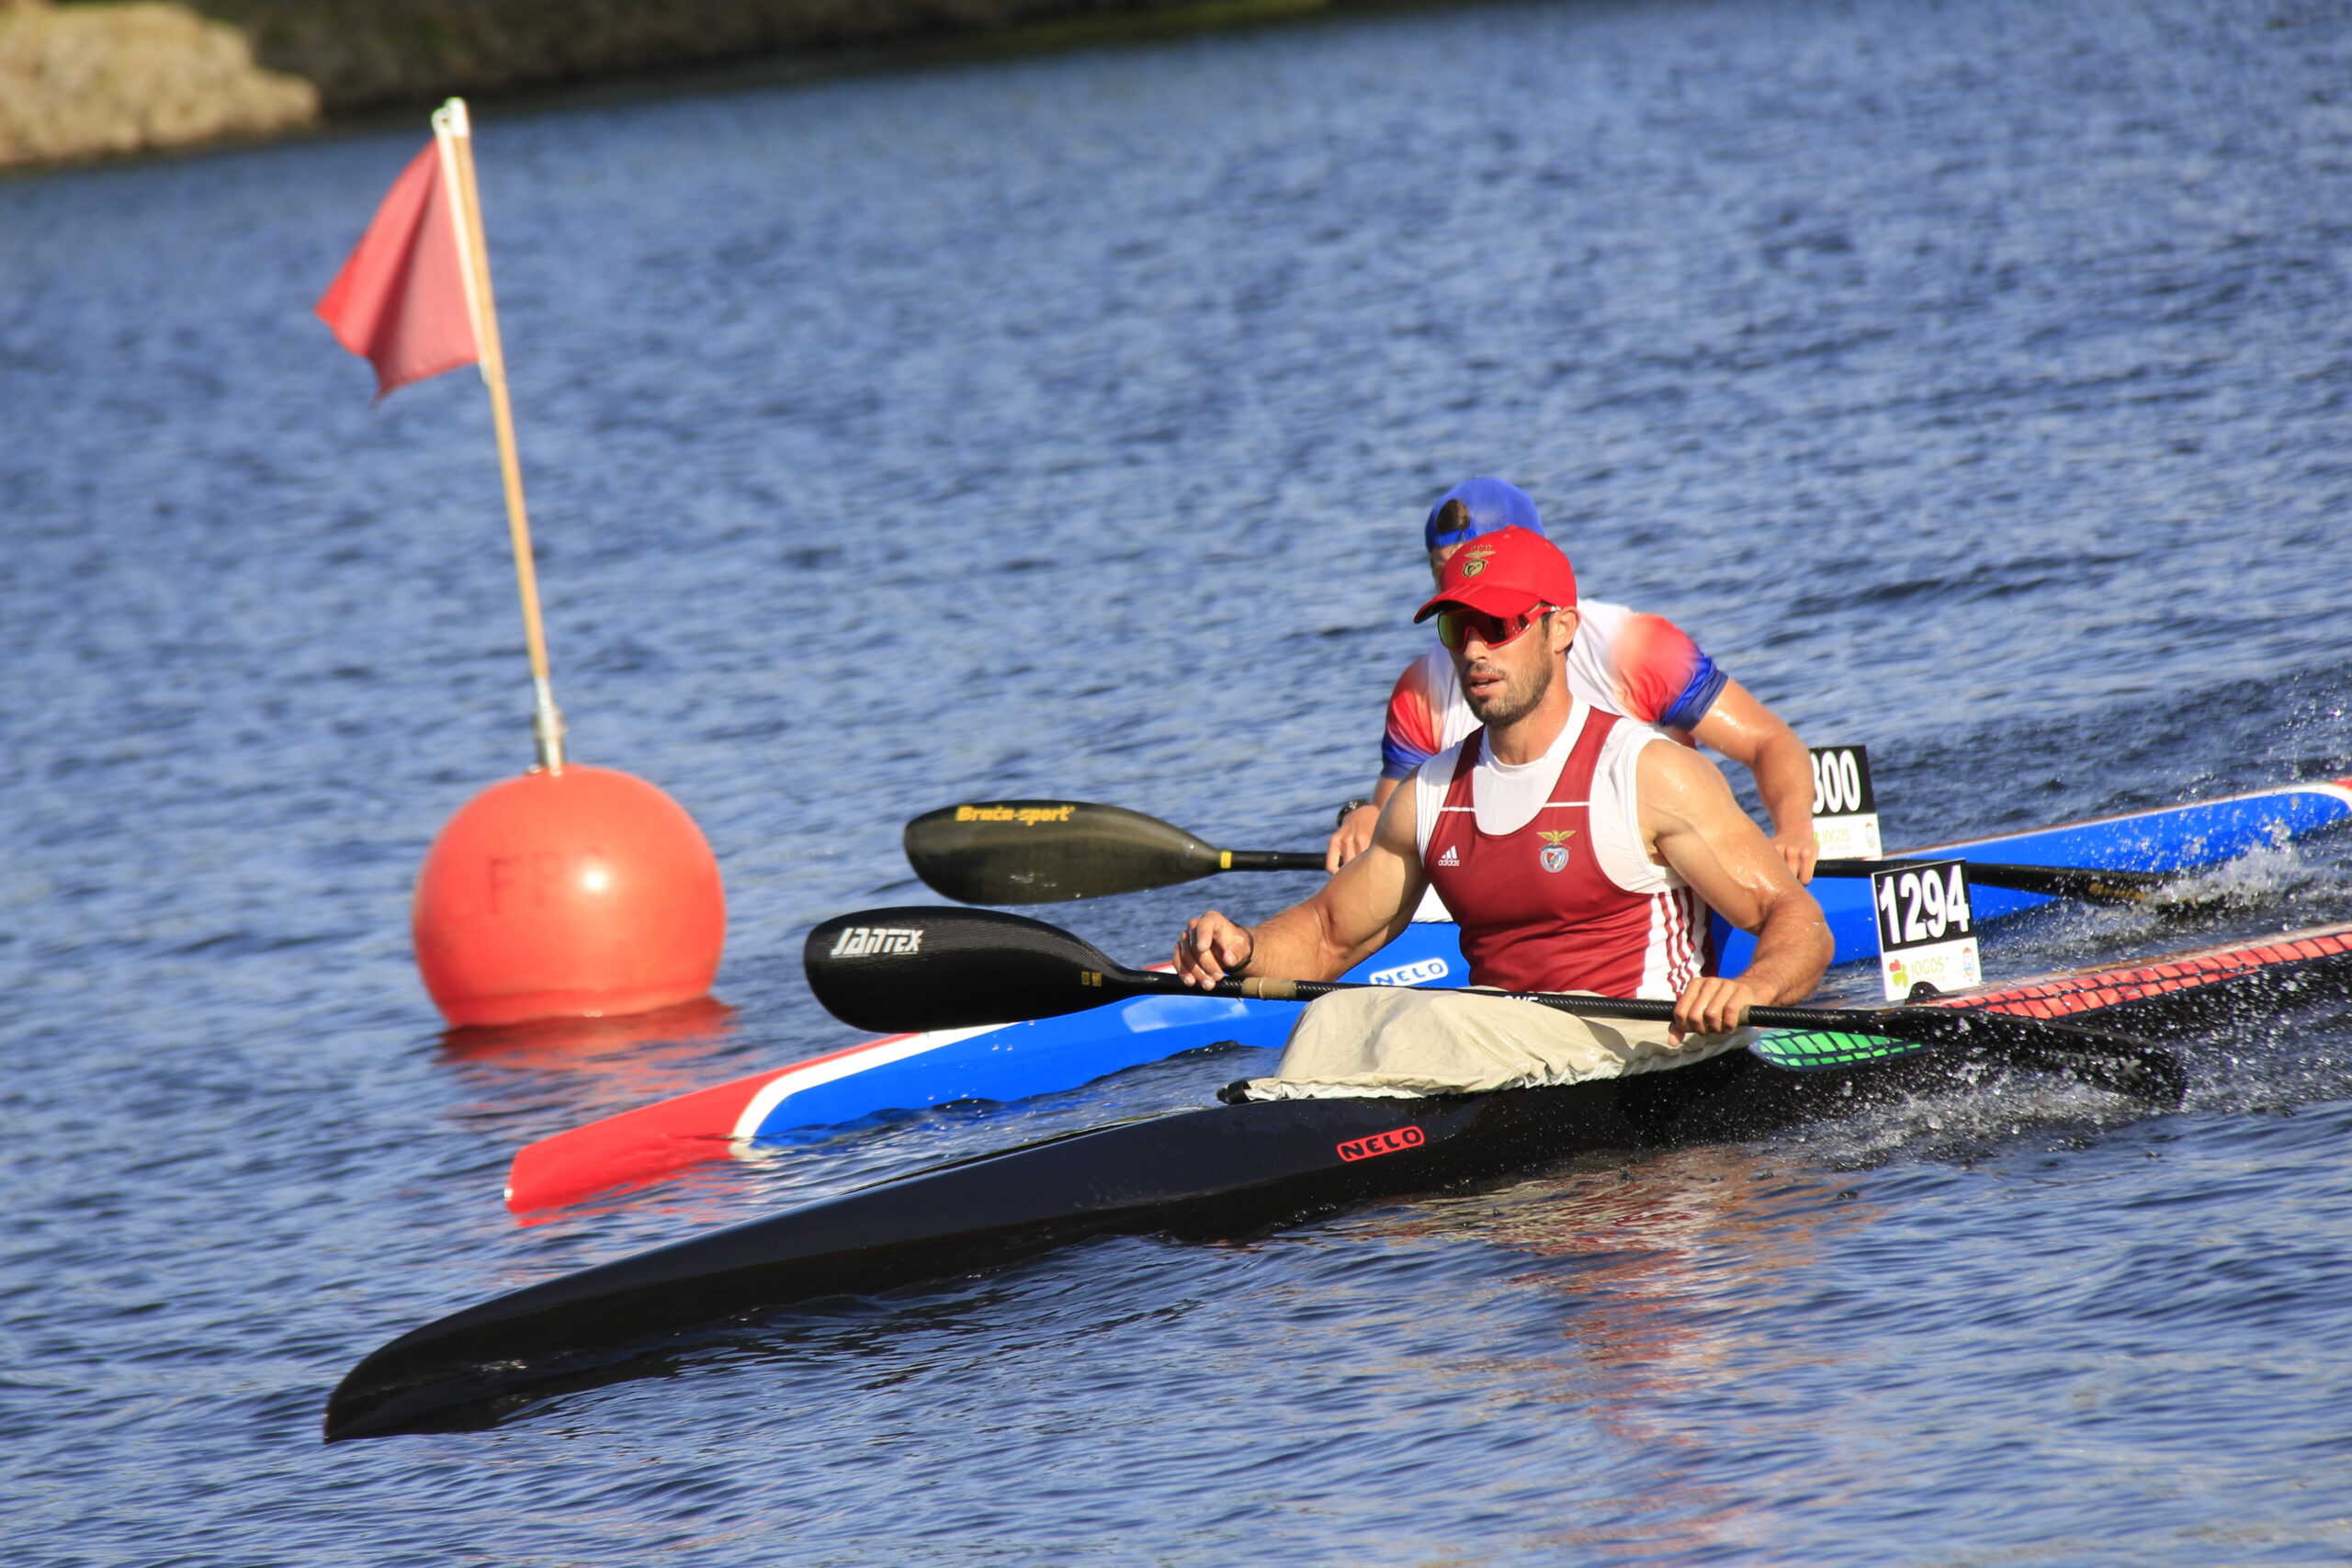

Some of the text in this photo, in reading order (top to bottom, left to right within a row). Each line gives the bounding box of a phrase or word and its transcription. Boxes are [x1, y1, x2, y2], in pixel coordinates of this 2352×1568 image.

[1438, 858, 1460, 867] adidas
[1880, 864, 1971, 945] 1294
[1374, 963, 1444, 986] NELO
[1340, 1128, 1422, 1160] NELO
